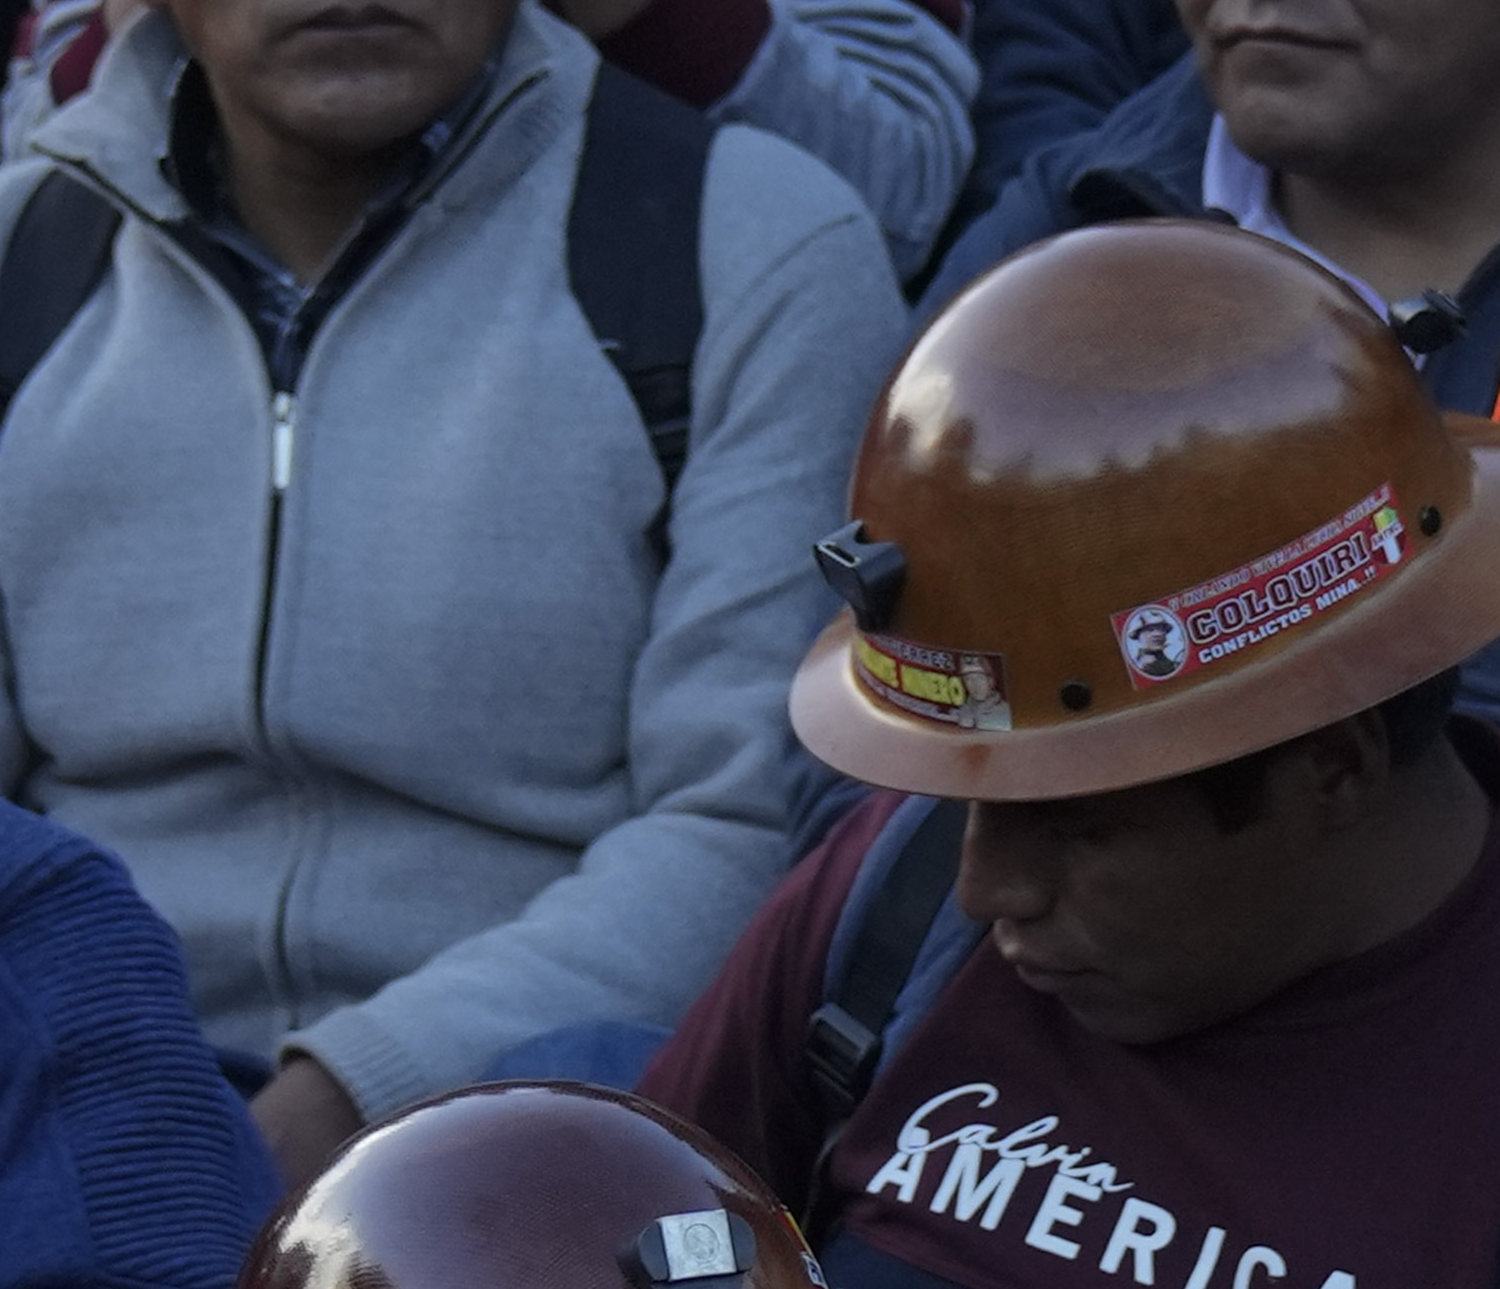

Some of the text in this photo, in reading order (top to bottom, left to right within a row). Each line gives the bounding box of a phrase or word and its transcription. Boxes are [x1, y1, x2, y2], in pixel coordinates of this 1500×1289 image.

[1188, 532, 1372, 644] COLQUIRI
[1198, 603, 1314, 665] CONFLICTOS
[896, 1082, 1134, 1193] Calvin
